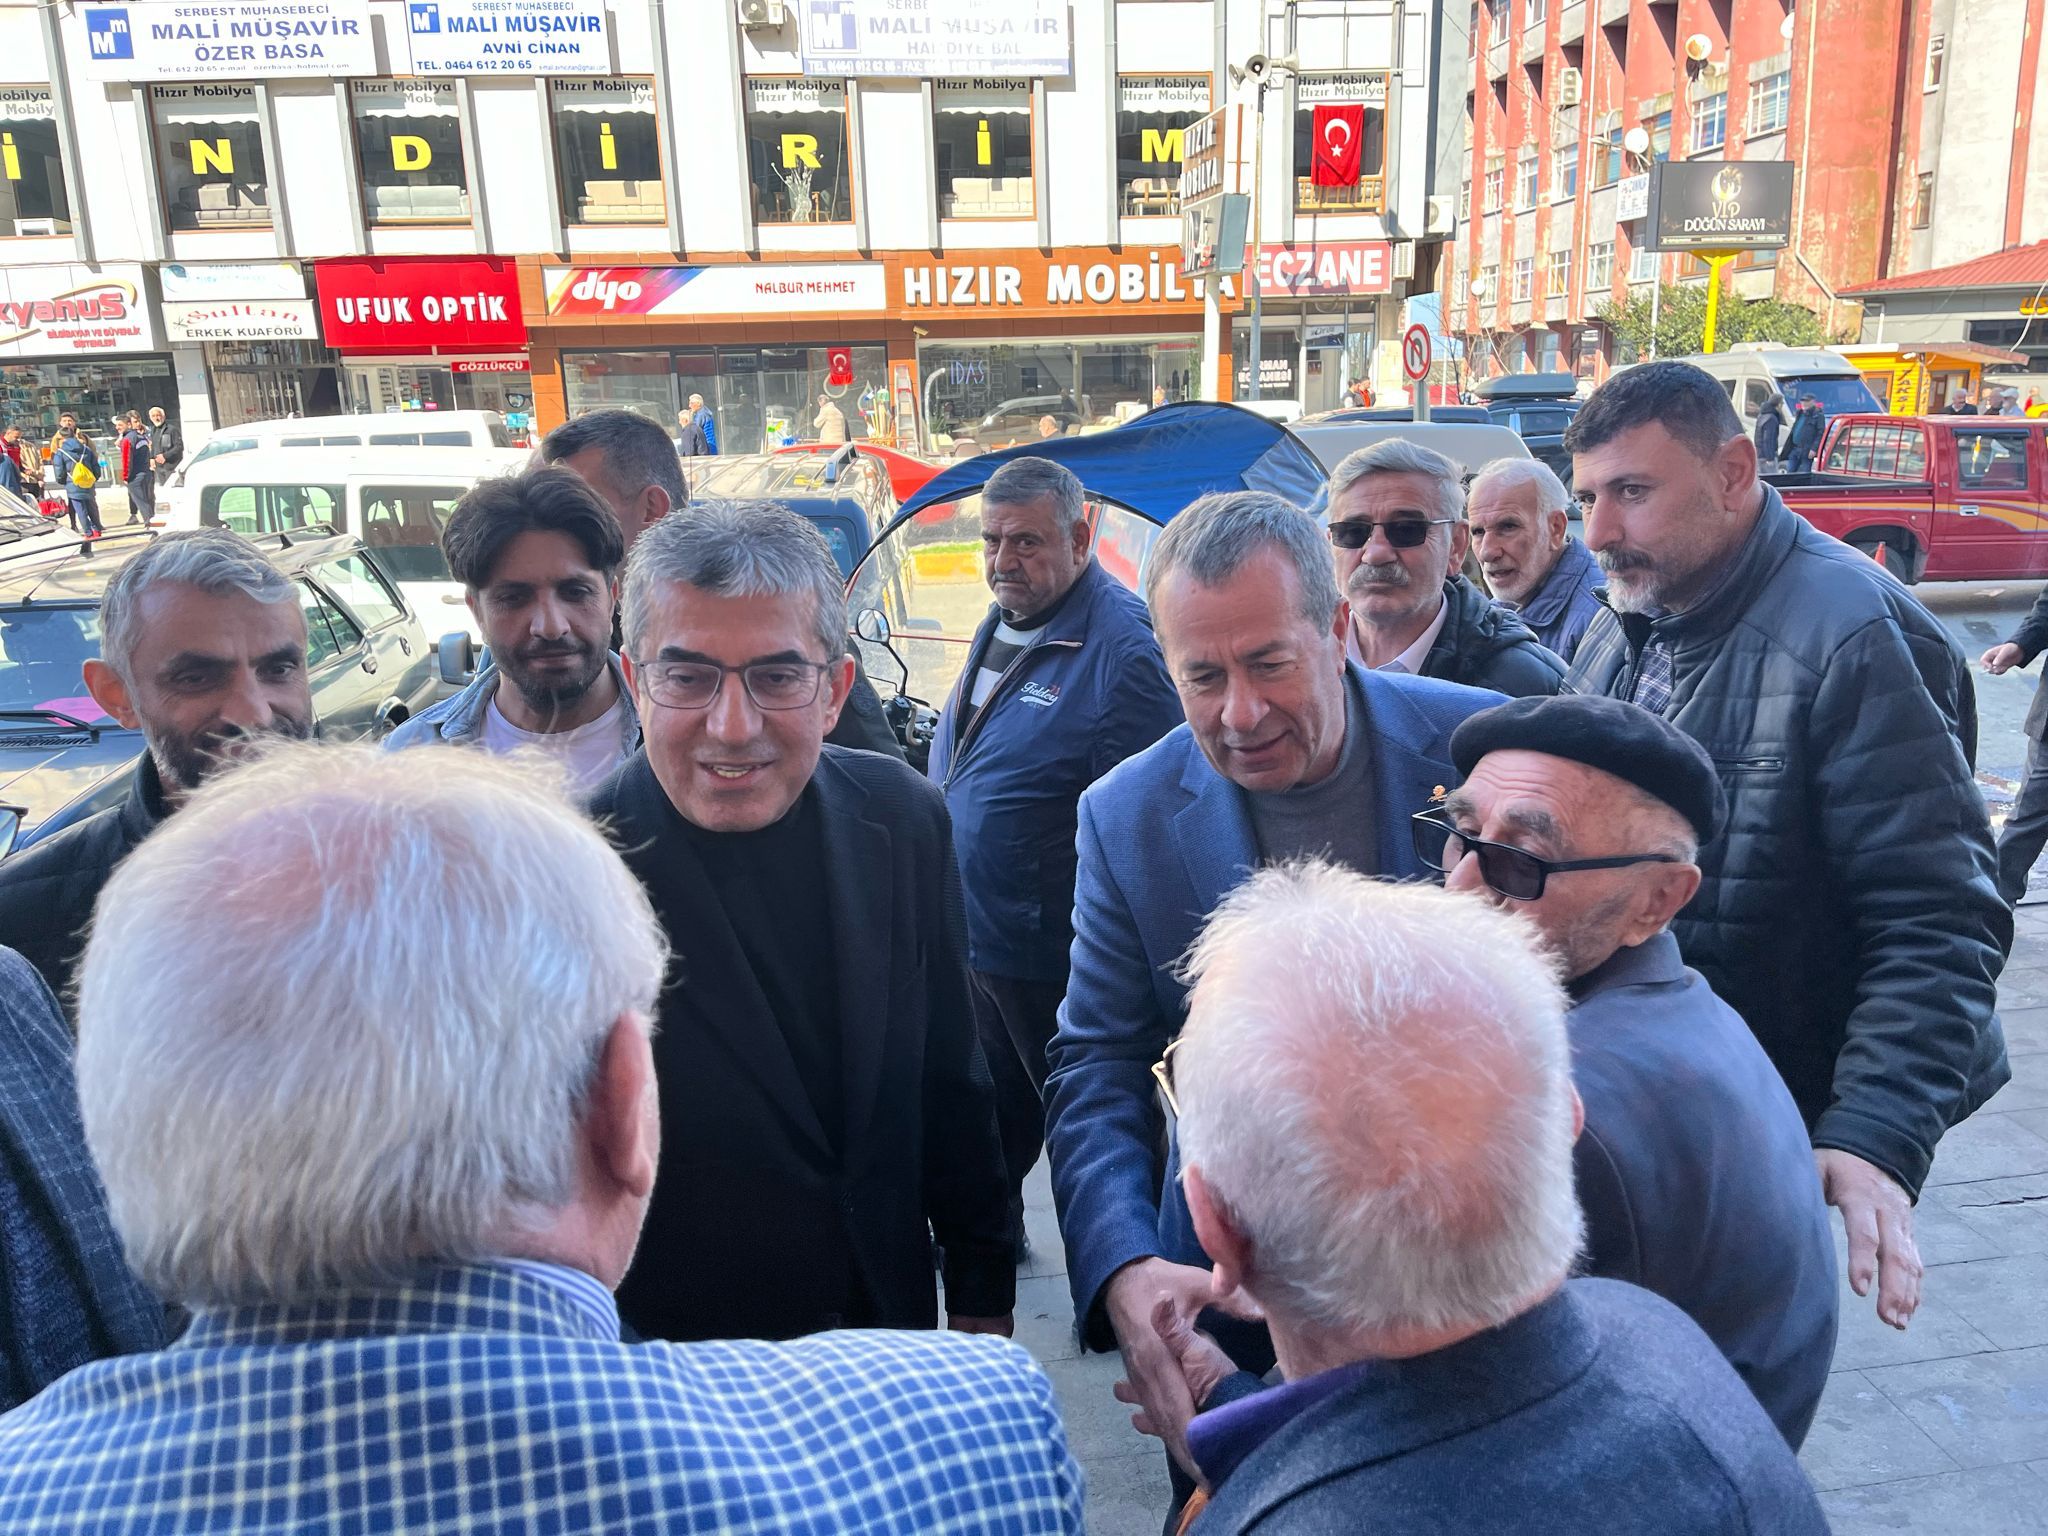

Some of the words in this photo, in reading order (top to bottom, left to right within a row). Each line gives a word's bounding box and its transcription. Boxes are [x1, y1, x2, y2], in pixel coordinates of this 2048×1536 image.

[174, 7, 236, 17] SERBEST
[241, 4, 329, 16] MUHASEBECİ
[472, 2, 512, 11] SERBEST
[151, 19, 220, 40] MALİ
[230, 16, 360, 41] MÜŞAVİR
[448, 12, 497, 33] MALİ
[505, 12, 601, 38] MÜŞAVİR
[195, 43, 256, 61] ÖZER
[264, 43, 325, 60] BASA
[482, 40, 522, 54] AVNİ
[528, 40, 580, 54] CİNAN
[416, 61, 442, 70] TEL.
[445, 61, 473, 70] 0464
[476, 61, 497, 70] 612
[500, 60, 515, 69] 20
[518, 60, 532, 69] 65
[354, 81, 388, 92] Hızır
[393, 80, 452, 94] Mobilya
[554, 80, 587, 91] Hızır
[592, 80, 649, 93] Mobilya
[749, 80, 780, 91] Hızır
[786, 79, 840, 92] Mobilya
[936, 79, 968, 89] Hızır
[973, 78, 1026, 91] Mobilya
[1120, 78, 1150, 89] Hızır
[1155, 77, 1206, 90] Mobilya
[1298, 76, 1327, 86] Hızır
[1332, 75, 1382, 87] Mobilya
[0, 90, 50, 102] obilya
[154, 86, 188, 98] Hızır
[193, 85, 253, 98] Mobilya
[1185, 118, 1216, 158] HIZIR
[1711, 202, 1741, 218] VIP
[1684, 217, 1726, 232] DÜĞÜN
[1727, 217, 1766, 231] SARAYI
[1259, 249, 1382, 288] ECZANE
[571, 271, 642, 310] dyo
[755, 282, 804, 294] NALBUR
[806, 281, 856, 293] MEHMET
[903, 265, 1023, 306] HIZIR
[186, 304, 299, 325] Sultan
[336, 297, 413, 324] UFUK
[421, 292, 508, 323] OPTİK
[186, 328, 232, 338] ERKEK
[237, 325, 303, 337] KUAFÖRÜ
[458, 360, 524, 373] GÖZLÜKÇÜ
